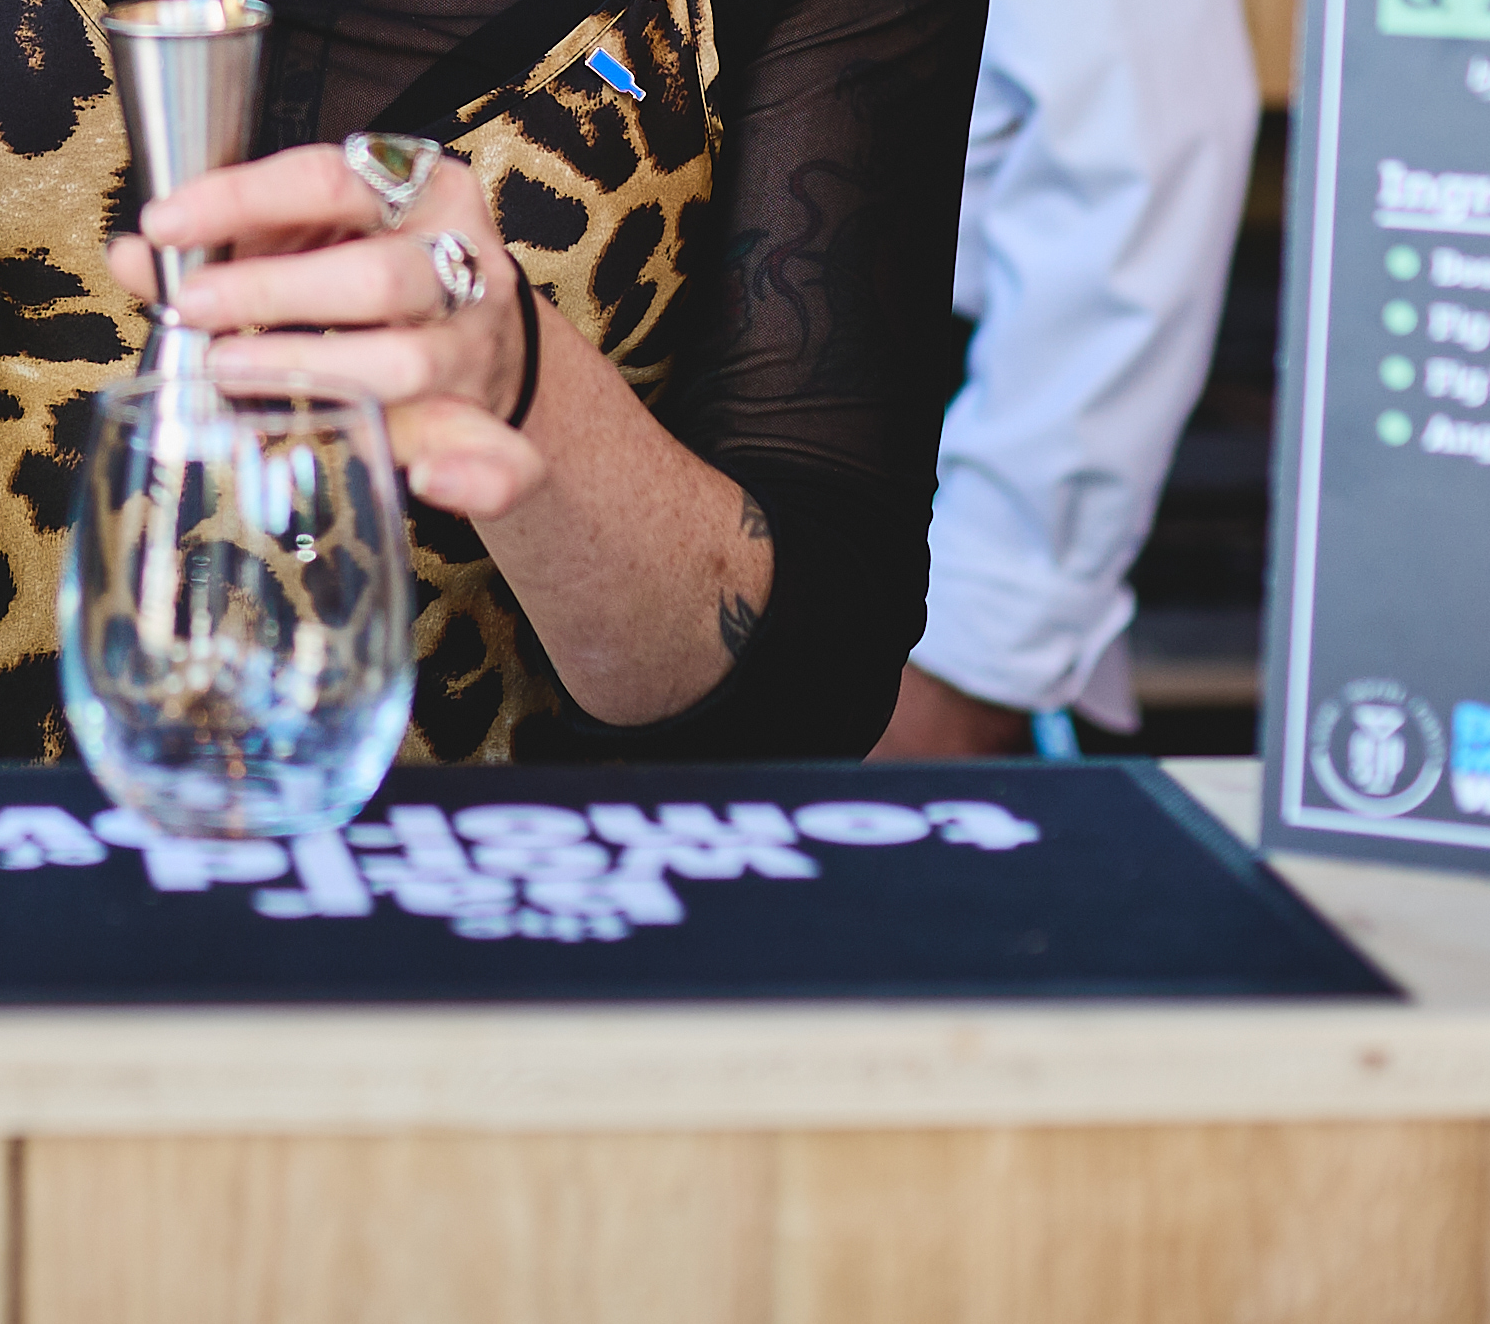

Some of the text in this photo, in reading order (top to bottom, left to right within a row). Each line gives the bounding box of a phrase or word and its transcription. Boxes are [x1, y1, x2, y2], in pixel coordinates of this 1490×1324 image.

[1423, 355, 1489, 408] Fig
[144, 833, 820, 891] world
[252, 865, 685, 927] bar
[450, 909, 631, 943] the
